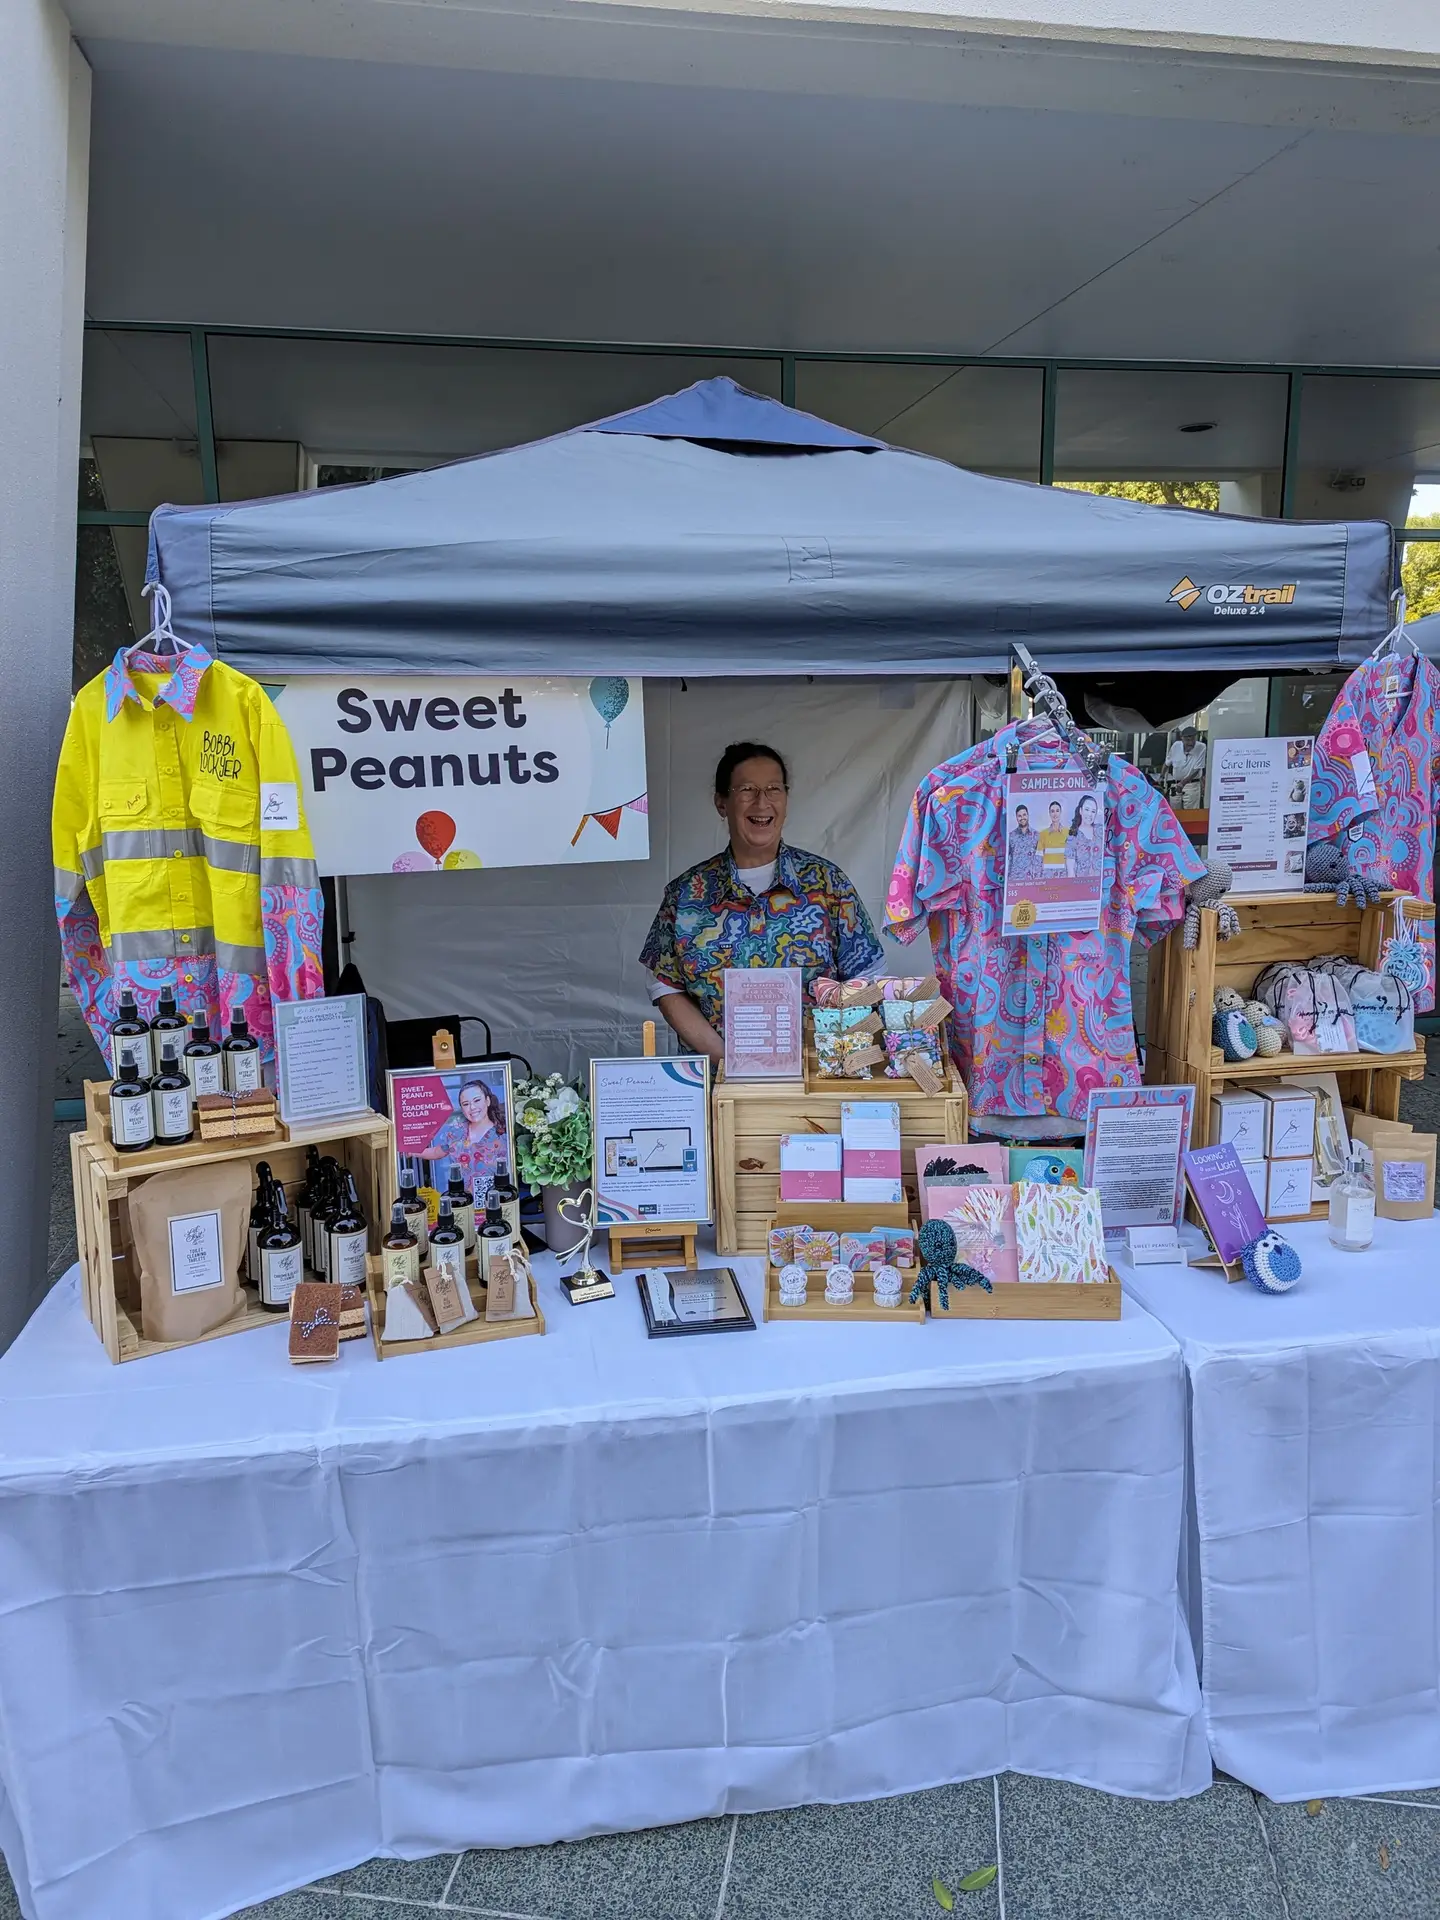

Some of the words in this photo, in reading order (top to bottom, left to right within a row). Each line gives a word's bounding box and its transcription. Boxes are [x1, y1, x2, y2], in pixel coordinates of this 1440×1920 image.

[1207, 584, 1296, 604] OZtrail
[1213, 605, 1248, 615] Deluxe
[1249, 606, 1266, 615] 2.4
[336, 687, 527, 733] Sweet
[203, 730, 235, 756] BOBBI
[200, 752, 242, 782] LOCKYER
[310, 745, 560, 792] Peanuts
[1220, 759, 1244, 770] Care
[1245, 758, 1271, 769] Items
[1021, 776, 1065, 790] SAMPLES
[1067, 776, 1091, 789] ONL
[600, 1077, 622, 1087] Sweet
[625, 1075, 656, 1086] Peanuts
[401, 1085, 425, 1094] SWEET
[401, 1091, 434, 1100] PEANUTS
[402, 1102, 444, 1112] TRADEMUTT
[402, 1109, 430, 1118] COLLAB
[1190, 1151, 1224, 1165] LOOKING
[1215, 1160, 1237, 1171] LIGHT
